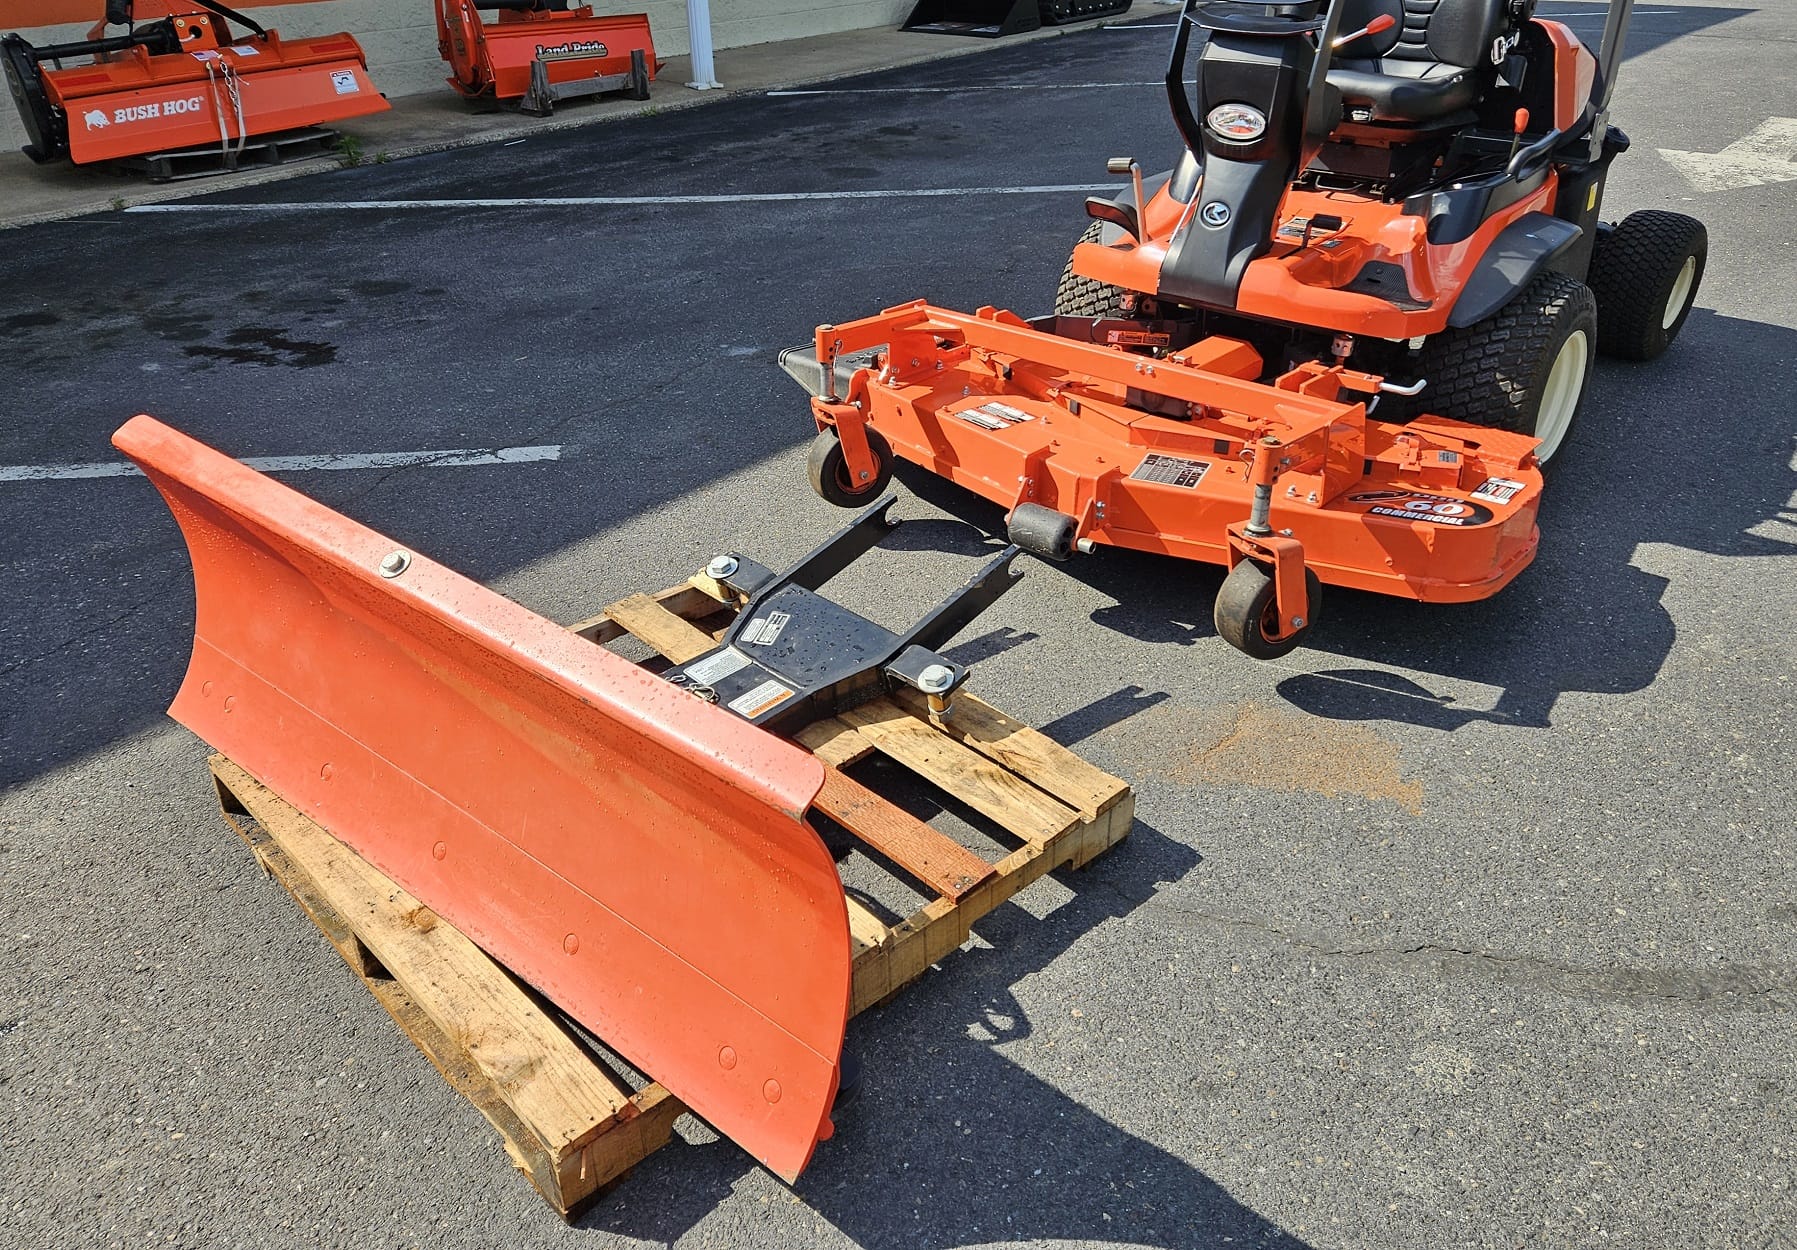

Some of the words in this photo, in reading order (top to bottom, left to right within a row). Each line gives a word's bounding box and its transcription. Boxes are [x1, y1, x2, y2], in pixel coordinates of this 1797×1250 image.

[536, 43, 569, 56] Land
[572, 41, 605, 54] Pride
[114, 104, 160, 123] BUSH
[1371, 507, 1464, 525] COMMERCIAL
[1404, 501, 1464, 515] 60
